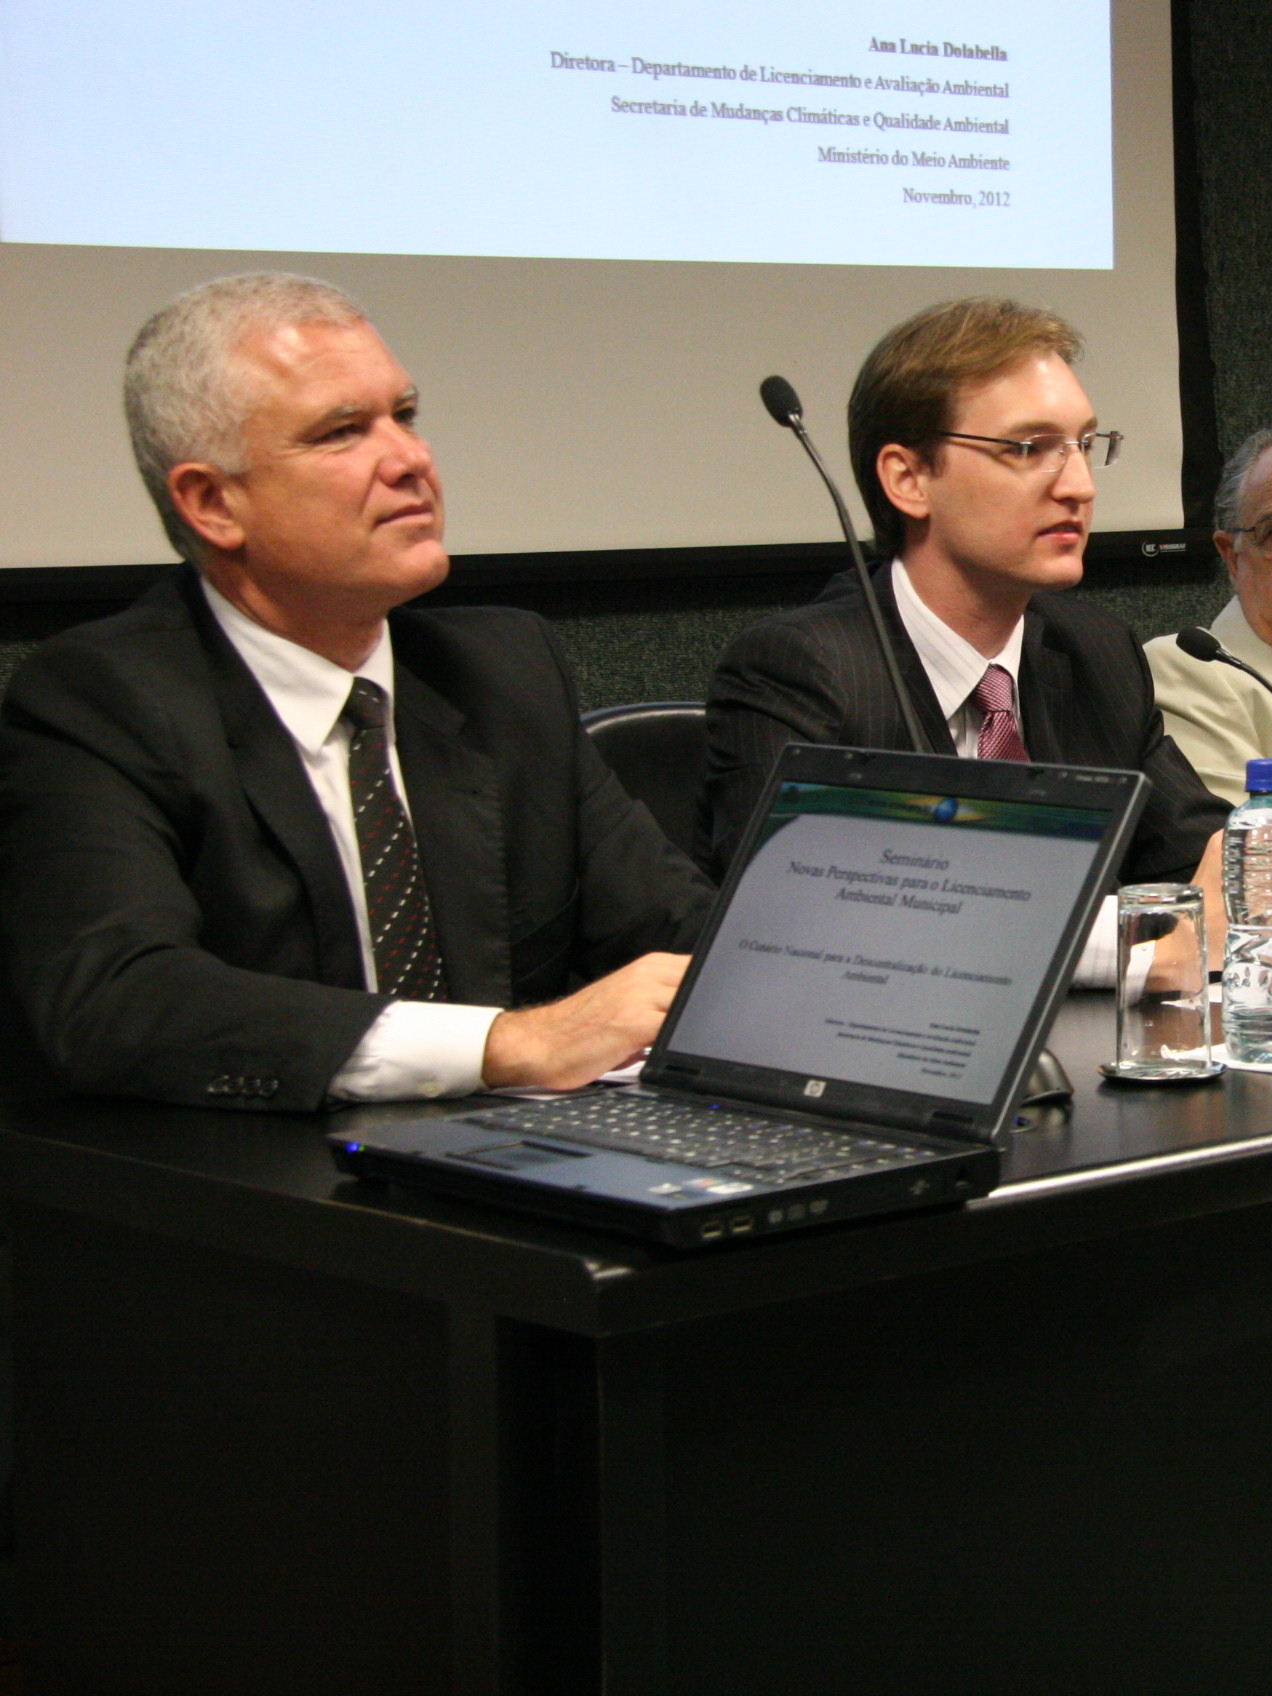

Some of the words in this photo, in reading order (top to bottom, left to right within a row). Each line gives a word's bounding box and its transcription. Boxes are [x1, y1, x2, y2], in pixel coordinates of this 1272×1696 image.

[869, 36, 897, 53] Ana
[899, 38, 939, 57] Lucia
[943, 41, 1009, 62] Dolabella
[549, 51, 616, 72] Diretora
[631, 56, 737, 81] Departamento
[739, 64, 758, 82] de
[759, 66, 862, 89] Licenciamento
[864, 78, 873, 90] e
[874, 75, 940, 97] Avaliação
[942, 80, 1010, 99] Ambiental
[610, 95, 687, 117] Secretaria
[689, 100, 708, 118] de
[710, 101, 784, 125] Mudanças
[786, 106, 860, 127] Climáticas
[863, 115, 872, 127] e
[873, 112, 941, 132] Qualidade
[943, 117, 1010, 135] Ambiental
[817, 146, 889, 166] Ministério
[891, 149, 909, 166] do
[911, 151, 946, 168] Meio
[948, 153, 1011, 171] Ambiente
[902, 187, 976, 209] Novembro,
[978, 191, 1011, 208] 2012
[881, 849, 949, 870] Seminário
[788, 861, 824, 878] Novas
[826, 865, 899, 887] Perspectivas
[901, 875, 929, 890] para
[930, 879, 940, 890] o
[941, 878, 1033, 901] Licenciamento
[835, 887, 898, 906] Ambiental
[900, 894, 964, 916] Municipal
